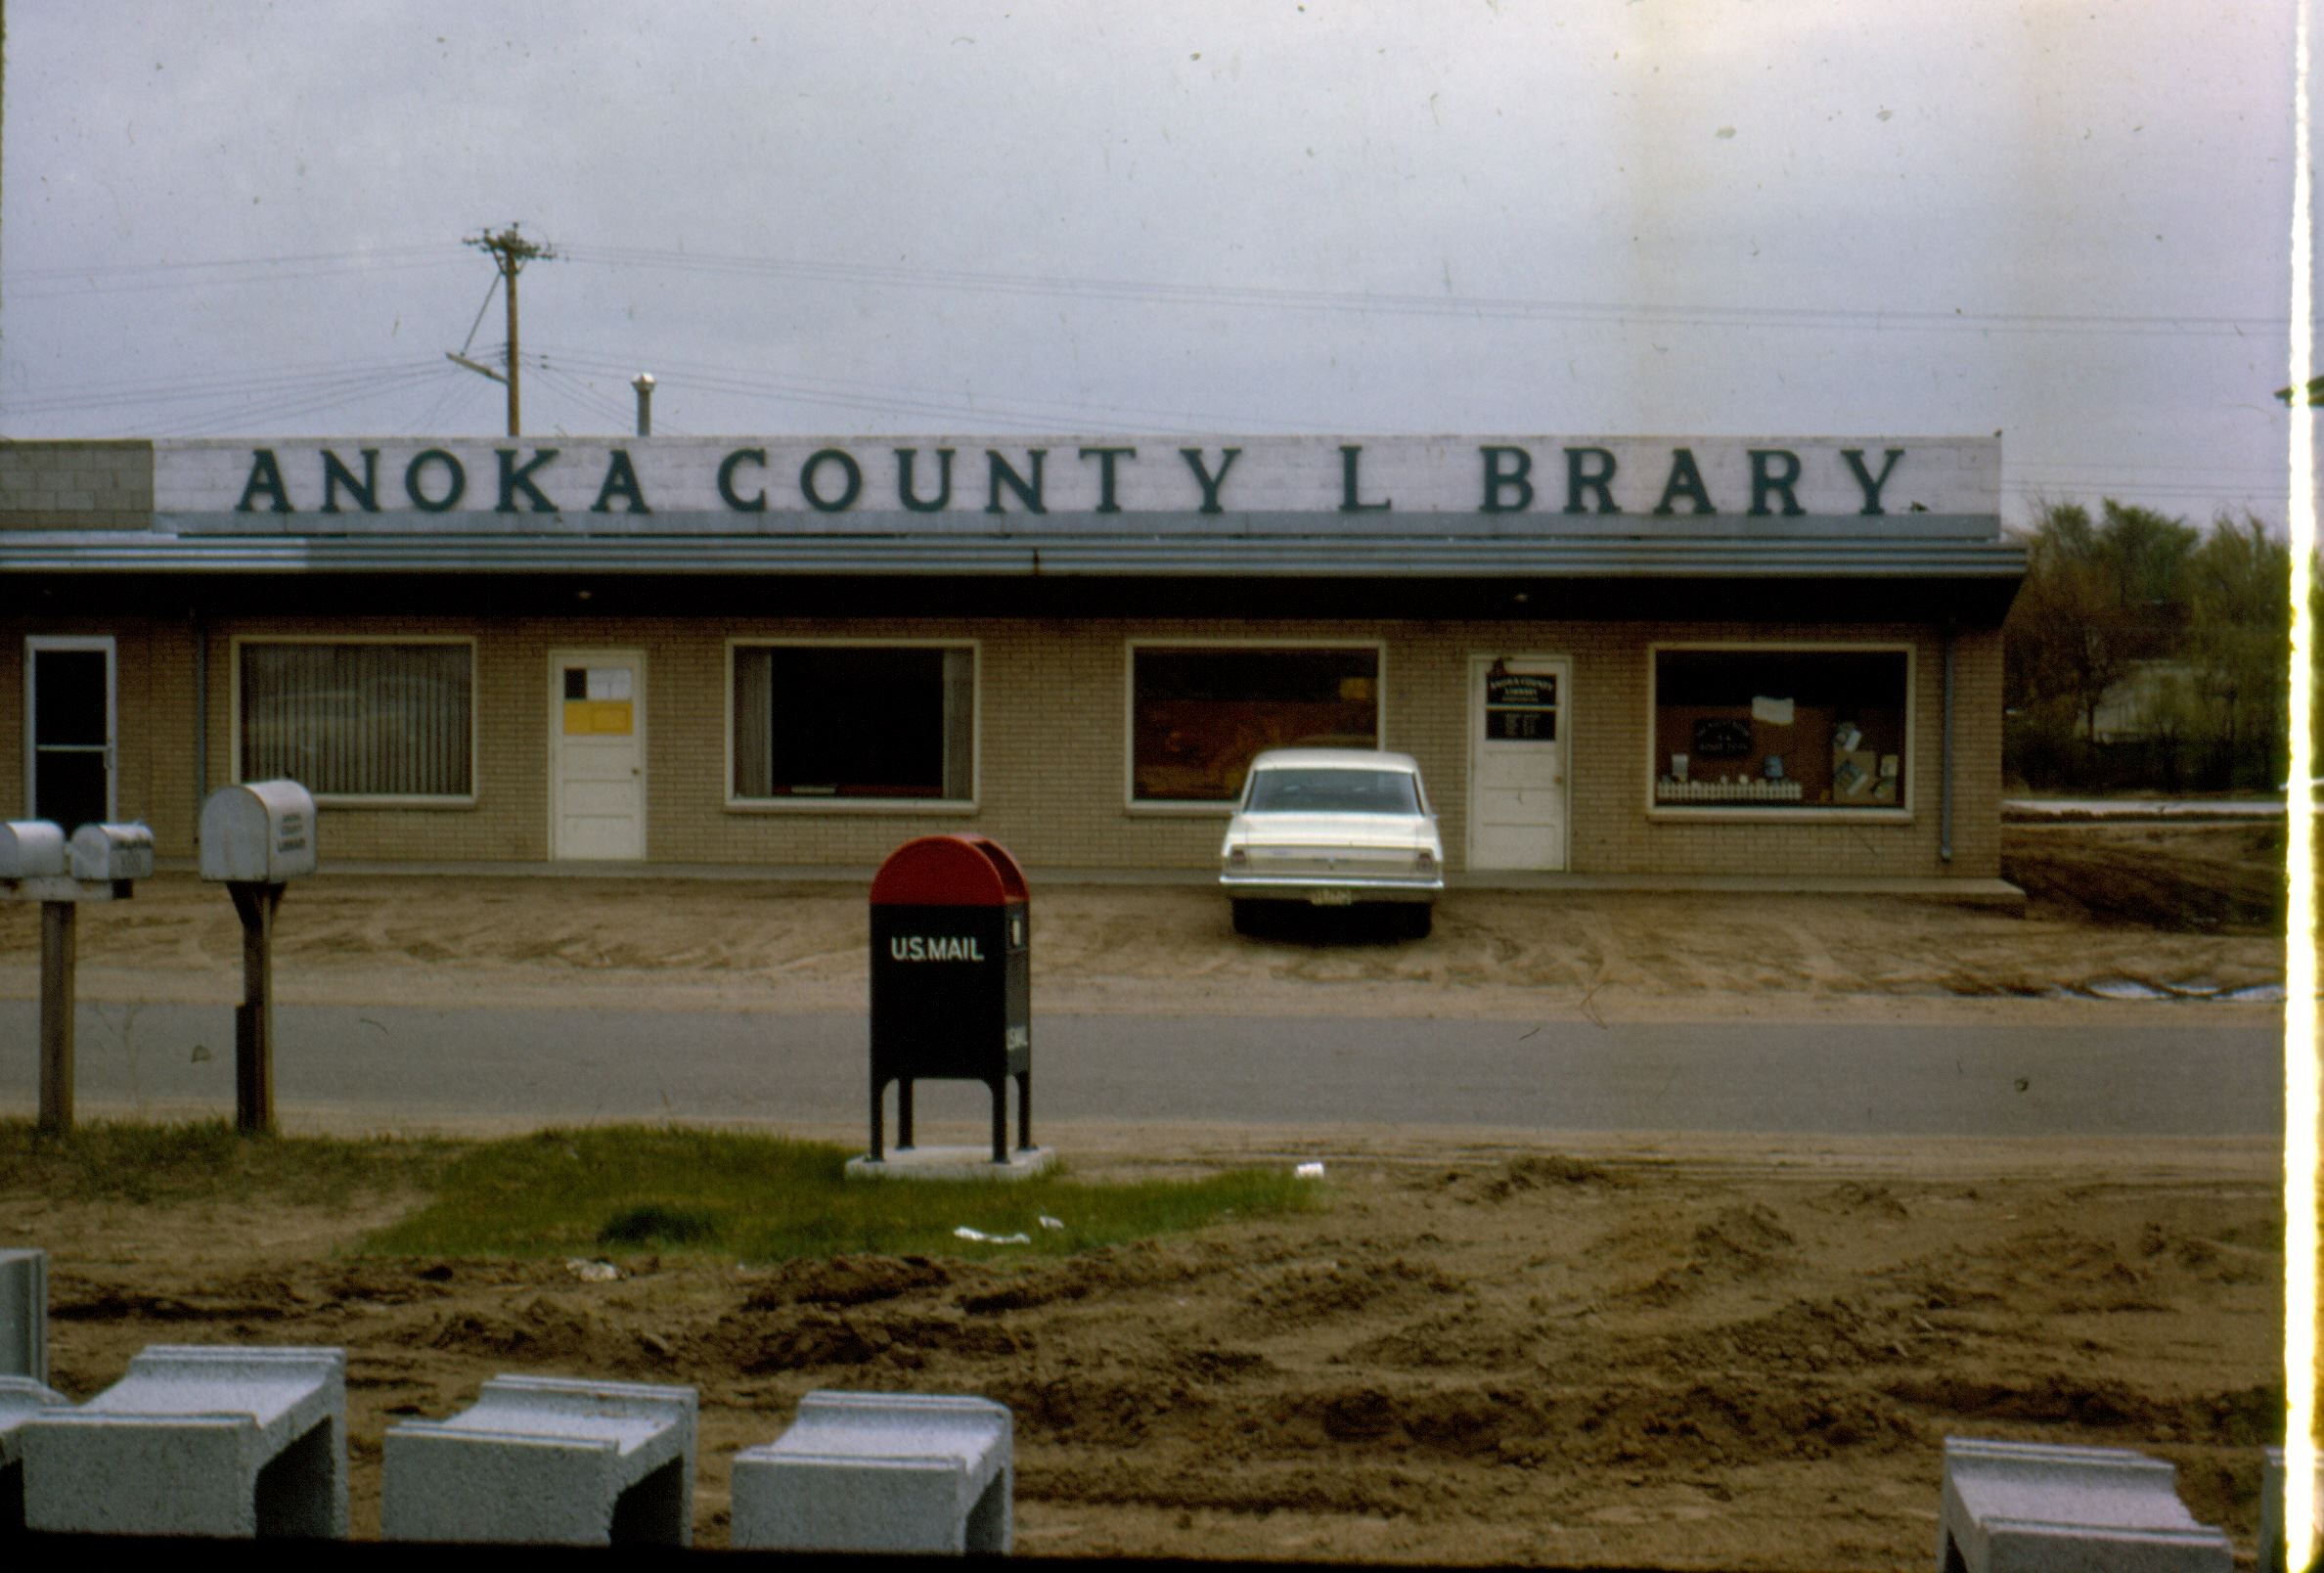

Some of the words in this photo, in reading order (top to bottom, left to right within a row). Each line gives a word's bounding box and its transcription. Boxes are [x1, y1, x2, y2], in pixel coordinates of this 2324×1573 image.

[235, 447, 651, 515] ANOKA
[717, 447, 1242, 515] COUNTY
[927, 936, 984, 961] MAIL
